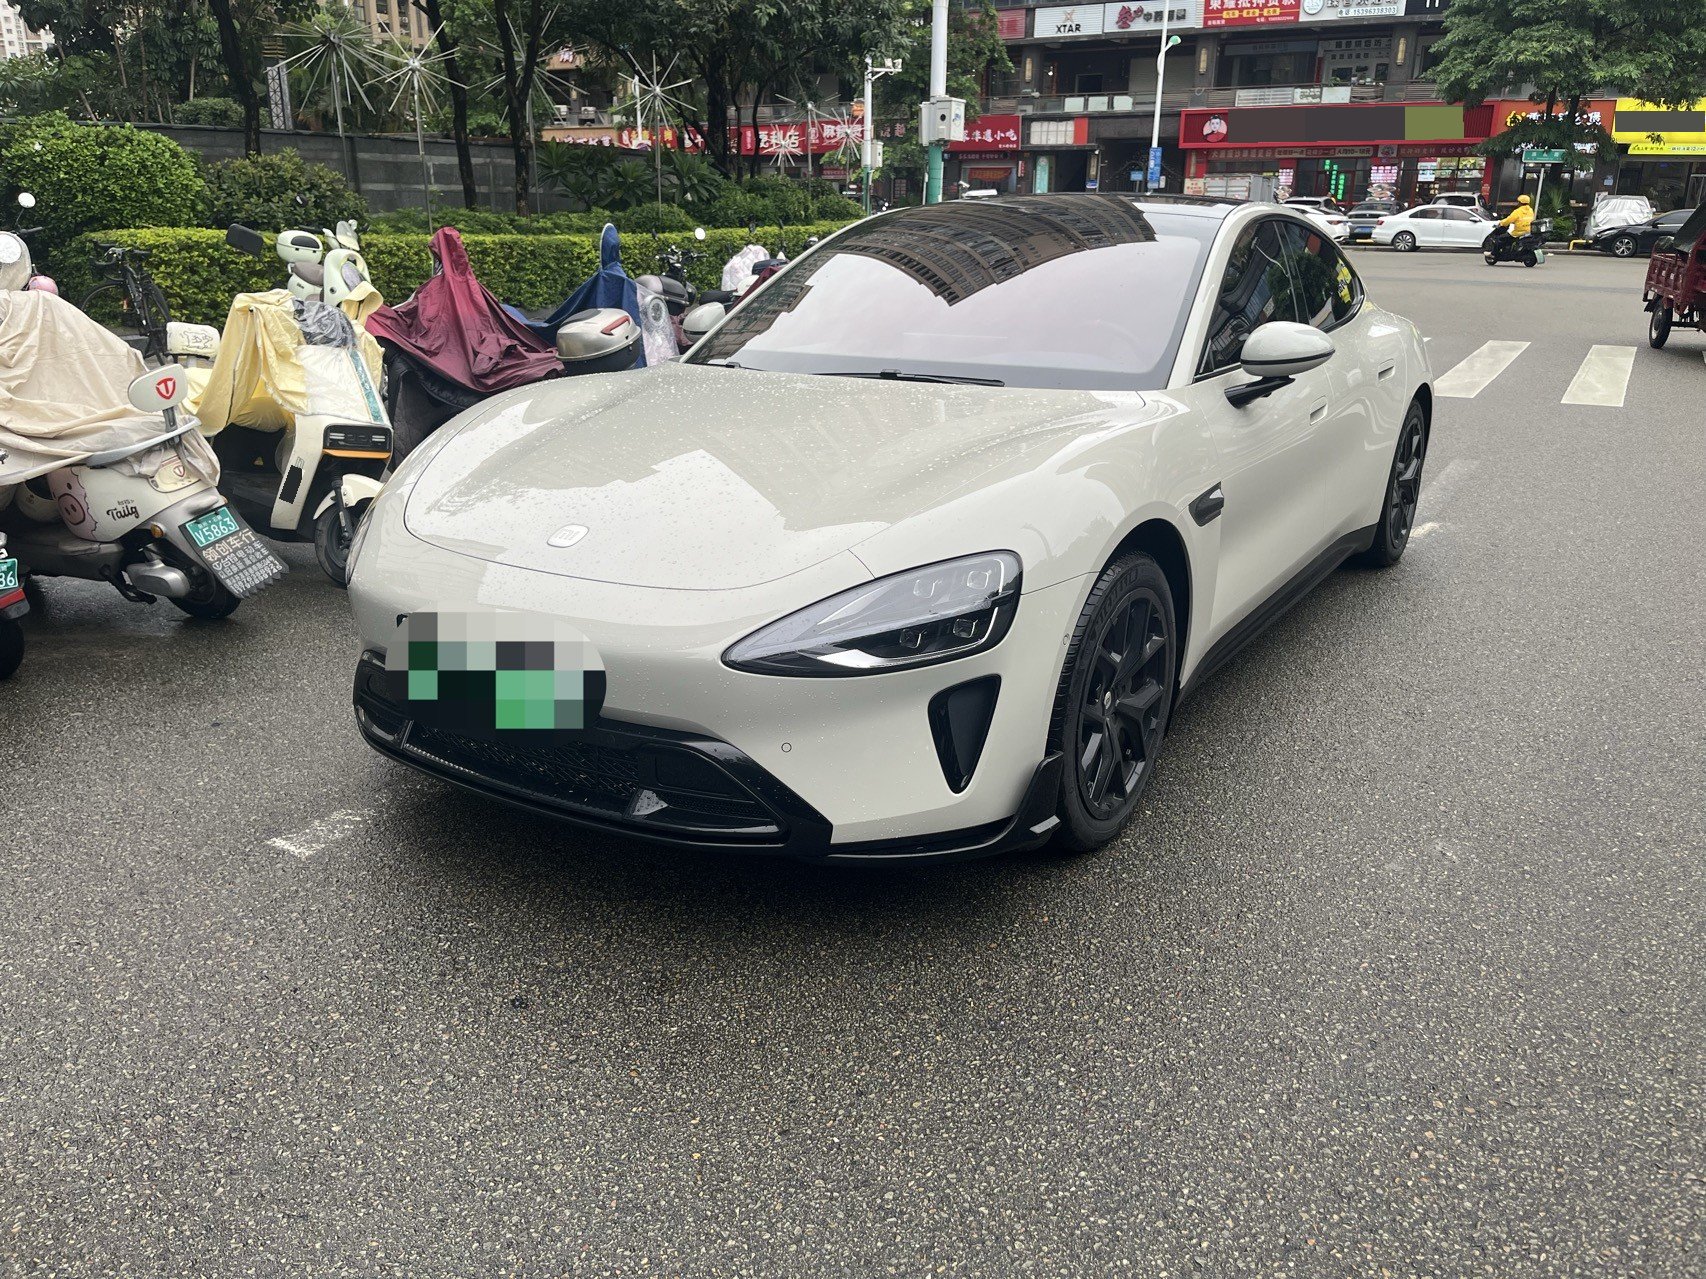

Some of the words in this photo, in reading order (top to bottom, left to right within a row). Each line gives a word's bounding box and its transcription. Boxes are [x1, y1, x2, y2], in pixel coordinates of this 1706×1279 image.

[1056, 23, 1081, 34] XTAR
[106, 505, 140, 521] Tailg
[195, 518, 236, 544] V5863
[202, 528, 256, 562] 领创车行
[221, 540, 264, 568] 台铃电动车
